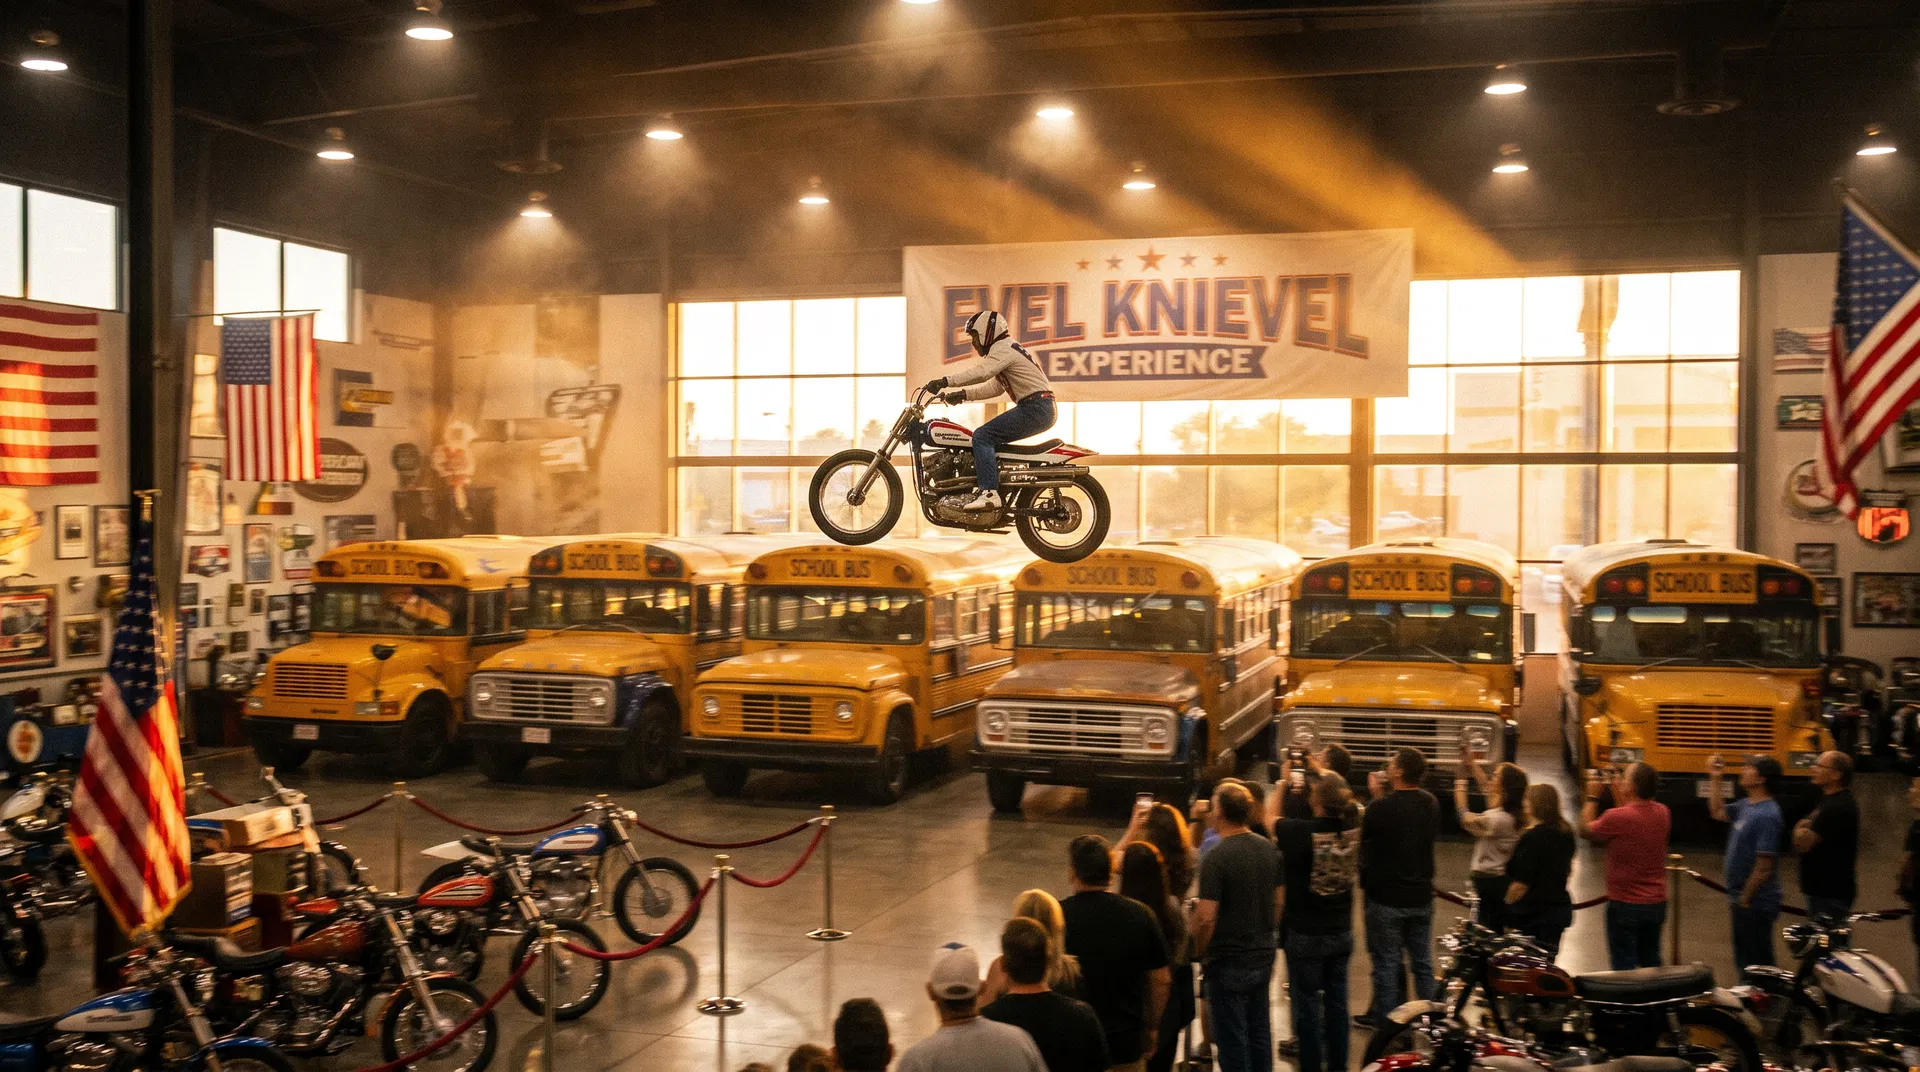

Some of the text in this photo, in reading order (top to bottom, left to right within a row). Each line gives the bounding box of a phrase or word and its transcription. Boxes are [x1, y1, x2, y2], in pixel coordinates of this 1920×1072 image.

[1102, 273, 1369, 359] KNIEVEL
[1049, 348, 1253, 377] EXPERIENCE
[567, 553, 641, 572] SCHOOL BUS
[791, 559, 871, 578] SCHOOL BUS
[1067, 565, 1156, 586] SCHOOL BUS
[1353, 570, 1446, 591] SCHOOL BUS
[1655, 571, 1751, 593] SCHOOL BUS
